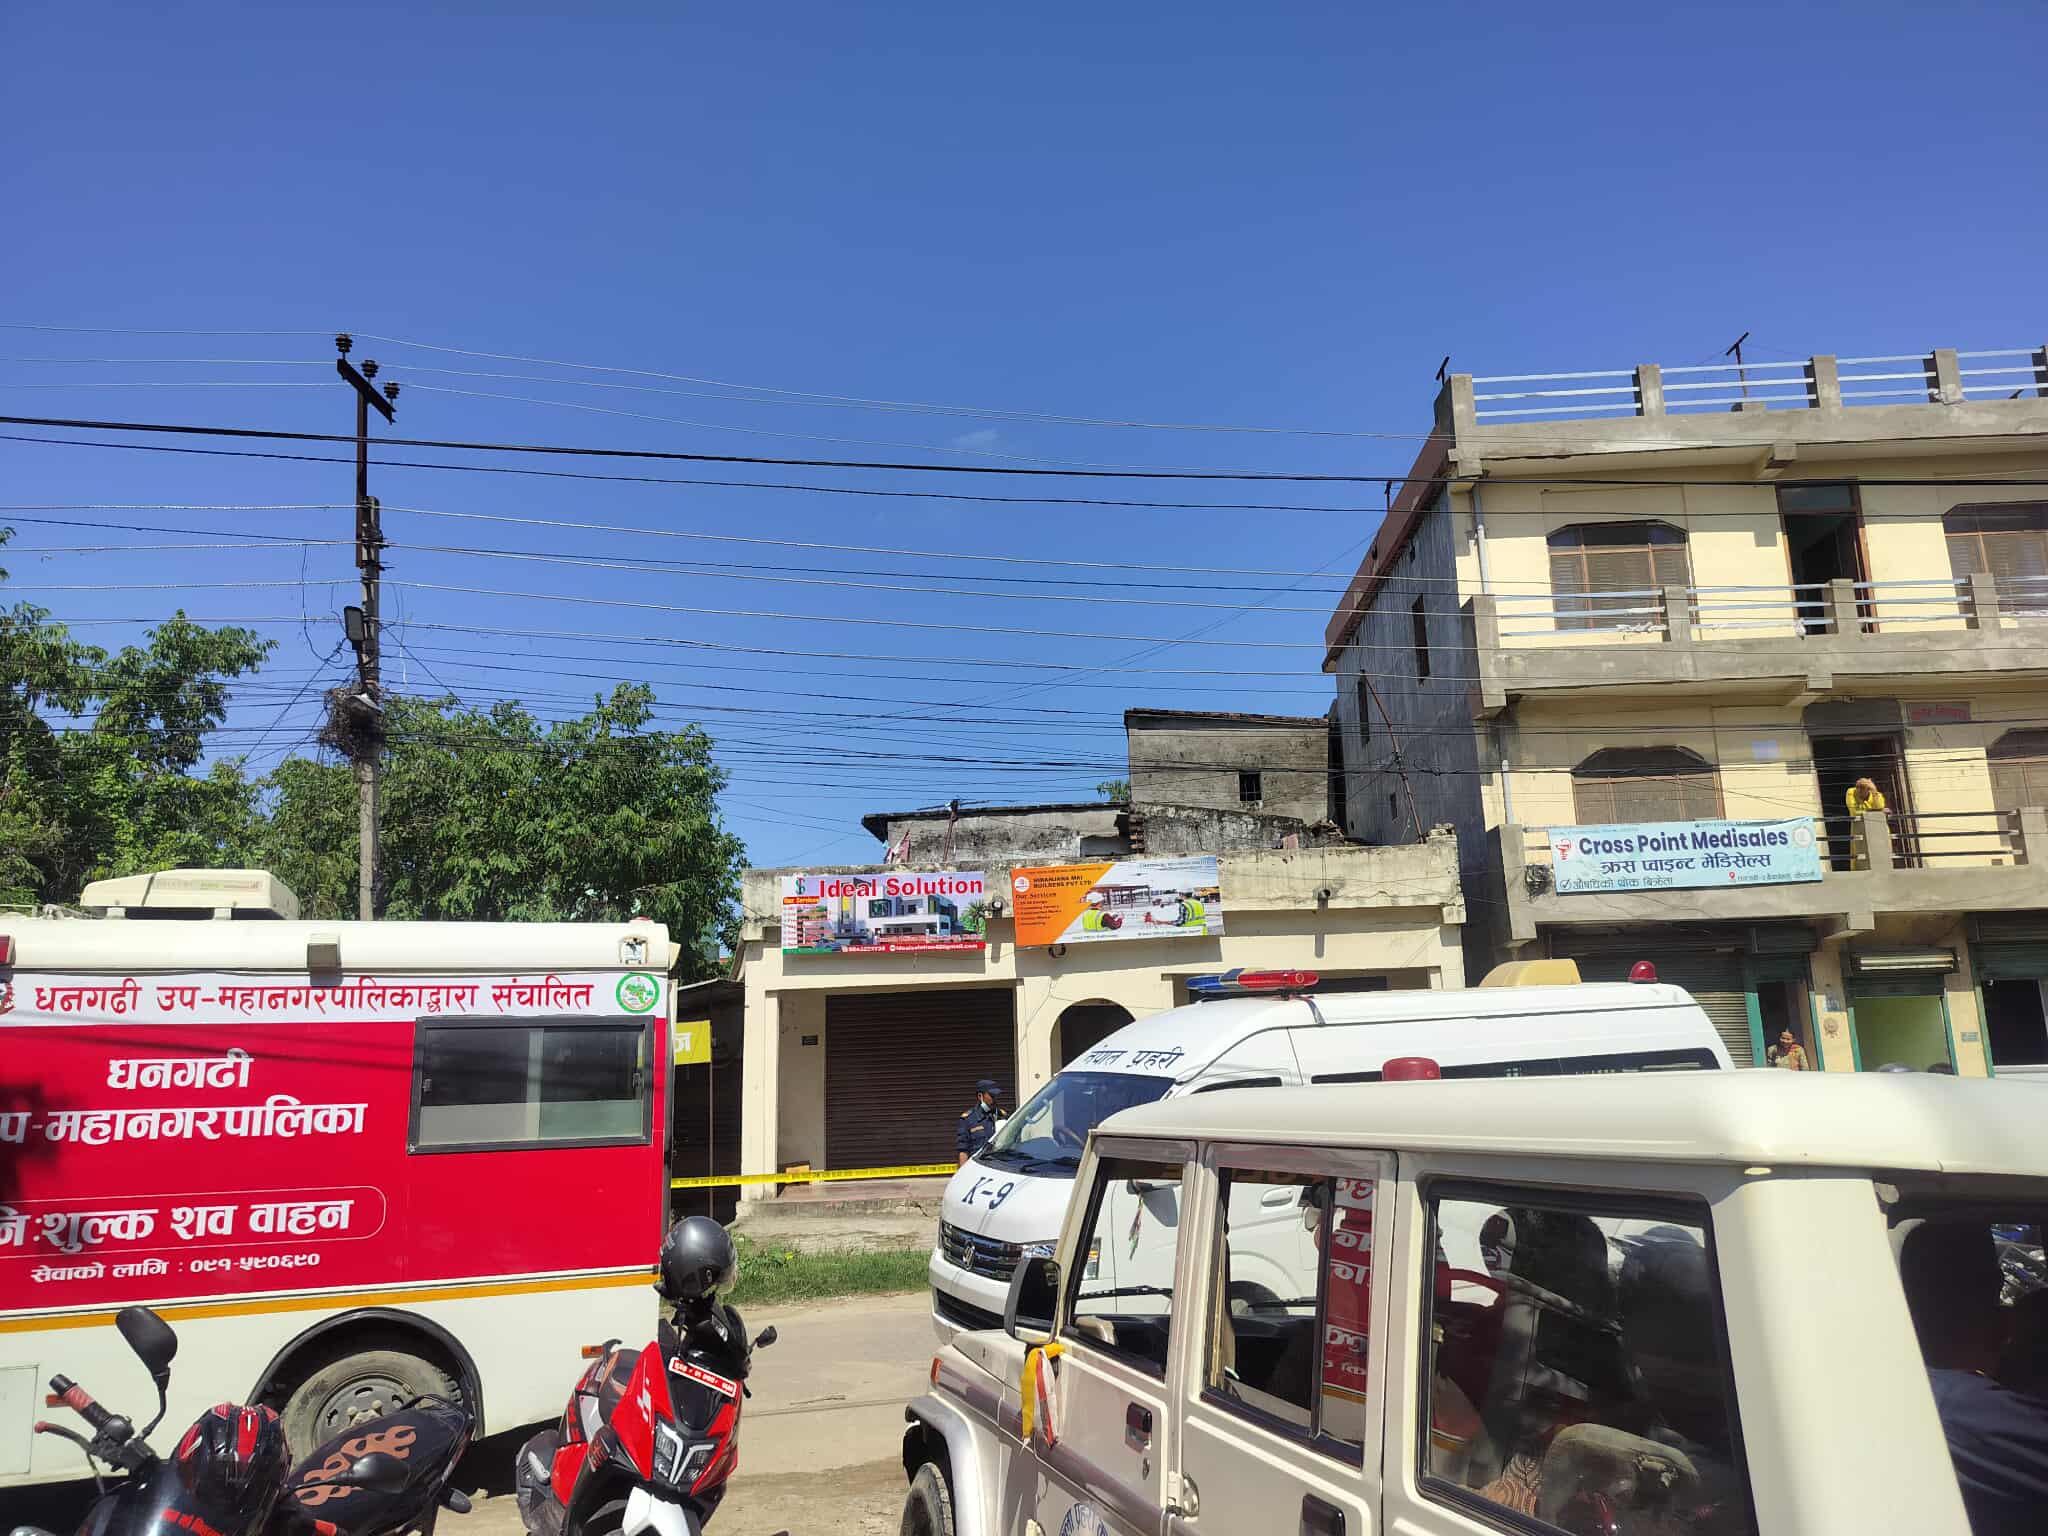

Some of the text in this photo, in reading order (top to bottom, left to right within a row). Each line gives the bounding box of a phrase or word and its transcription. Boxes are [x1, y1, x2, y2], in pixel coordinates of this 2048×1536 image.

[1579, 827, 1788, 855] Cross Point Medisales
[819, 876, 983, 899] Ideal Solution
[35, 977, 142, 1014] धनगढी
[491, 976, 595, 1013] संचालित
[107, 1047, 255, 1090] धनगढी
[0, 1094, 369, 1146] प-महानगरपालिका
[961, 1176, 1015, 1210] K-9
[170, 1204, 239, 1240] शव
[249, 1199, 355, 1240] वाहन
[30, 1261, 106, 1284] सेवाको
[112, 1258, 169, 1279] लागि
